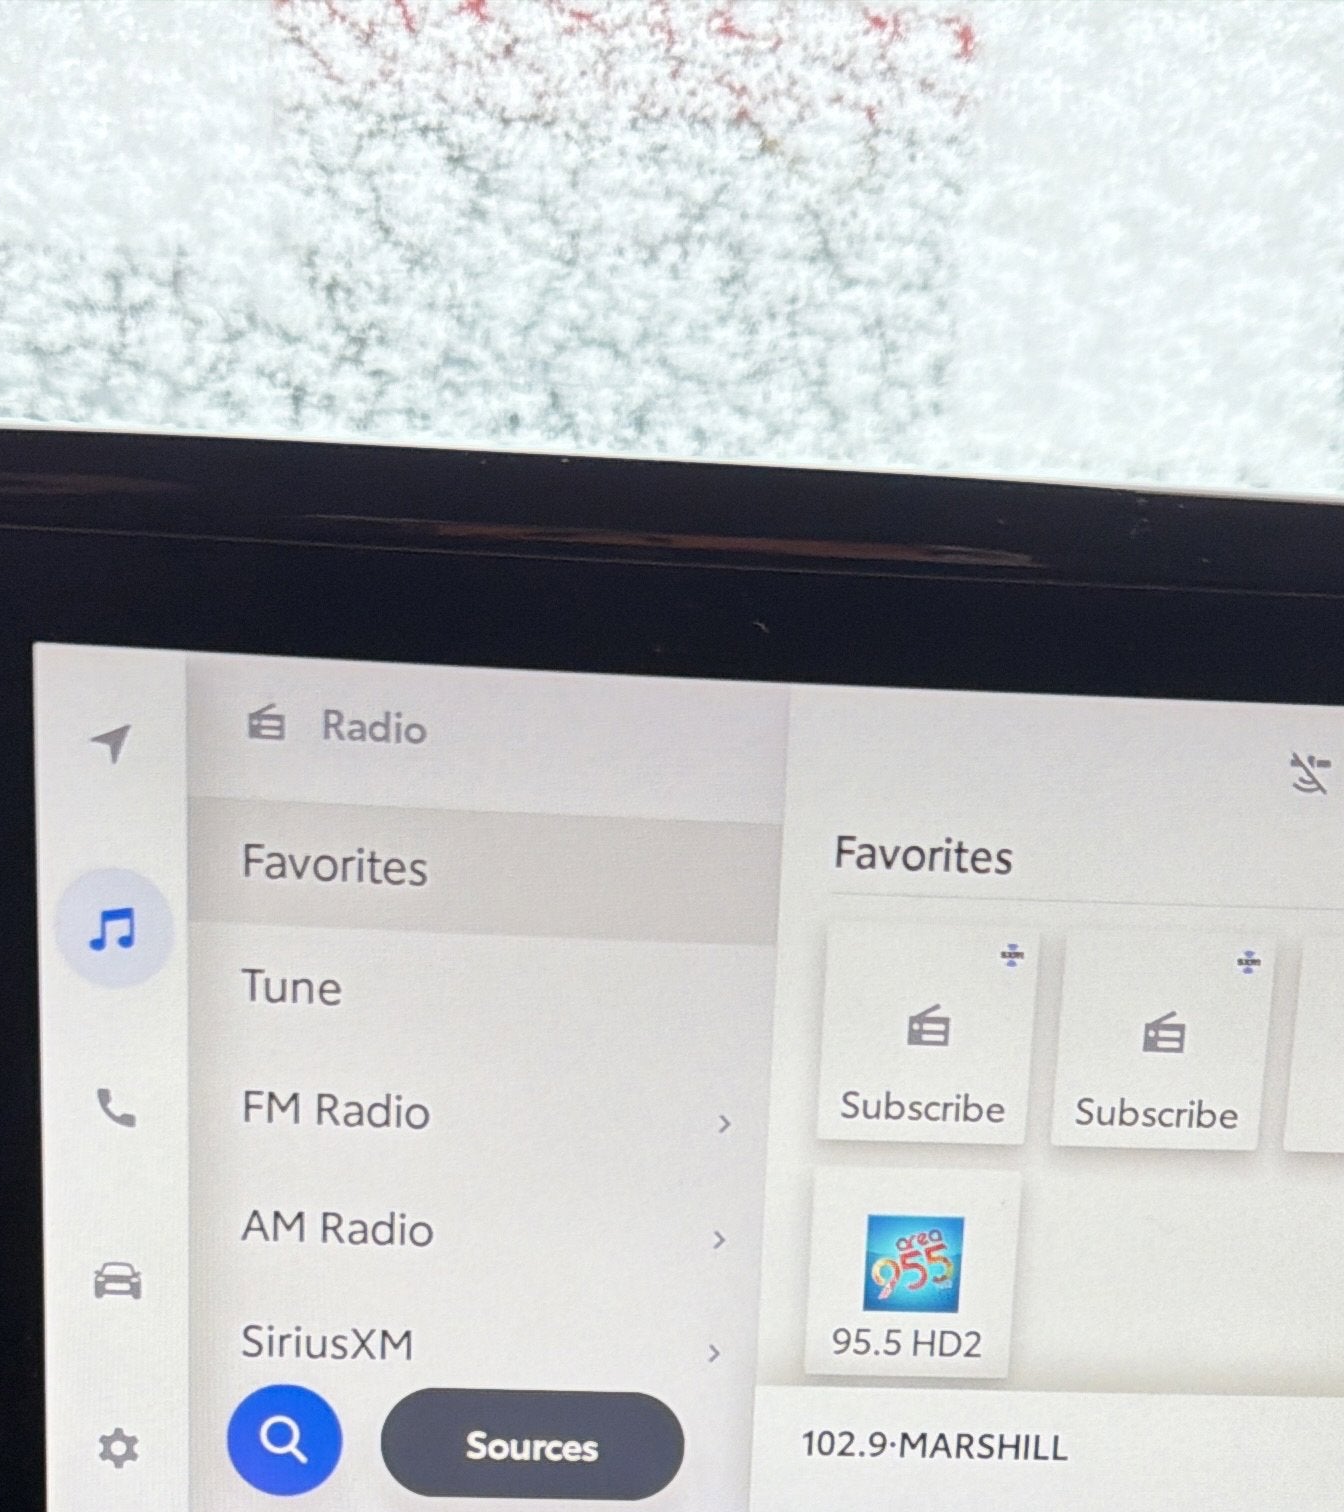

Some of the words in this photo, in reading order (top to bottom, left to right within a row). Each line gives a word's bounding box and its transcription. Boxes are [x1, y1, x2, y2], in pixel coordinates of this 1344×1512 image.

[324, 709, 426, 744] Radio
[245, 844, 427, 886] Favorites
[836, 836, 1012, 874] Favorites
[242, 969, 341, 1005] Tune
[245, 1091, 299, 1123] FM
[317, 1094, 429, 1129] Radio
[841, 1091, 1004, 1123] Subscribe
[1076, 1098, 1237, 1129] Subscribe
[242, 1210, 304, 1241] AM
[323, 1212, 433, 1246] Radio
[871, 1243, 954, 1300] 955
[243, 1325, 411, 1360] SiriusXM
[833, 1328, 901, 1355] 95.5
[913, 1330, 981, 1357] HD2
[467, 1431, 598, 1461] Sources
